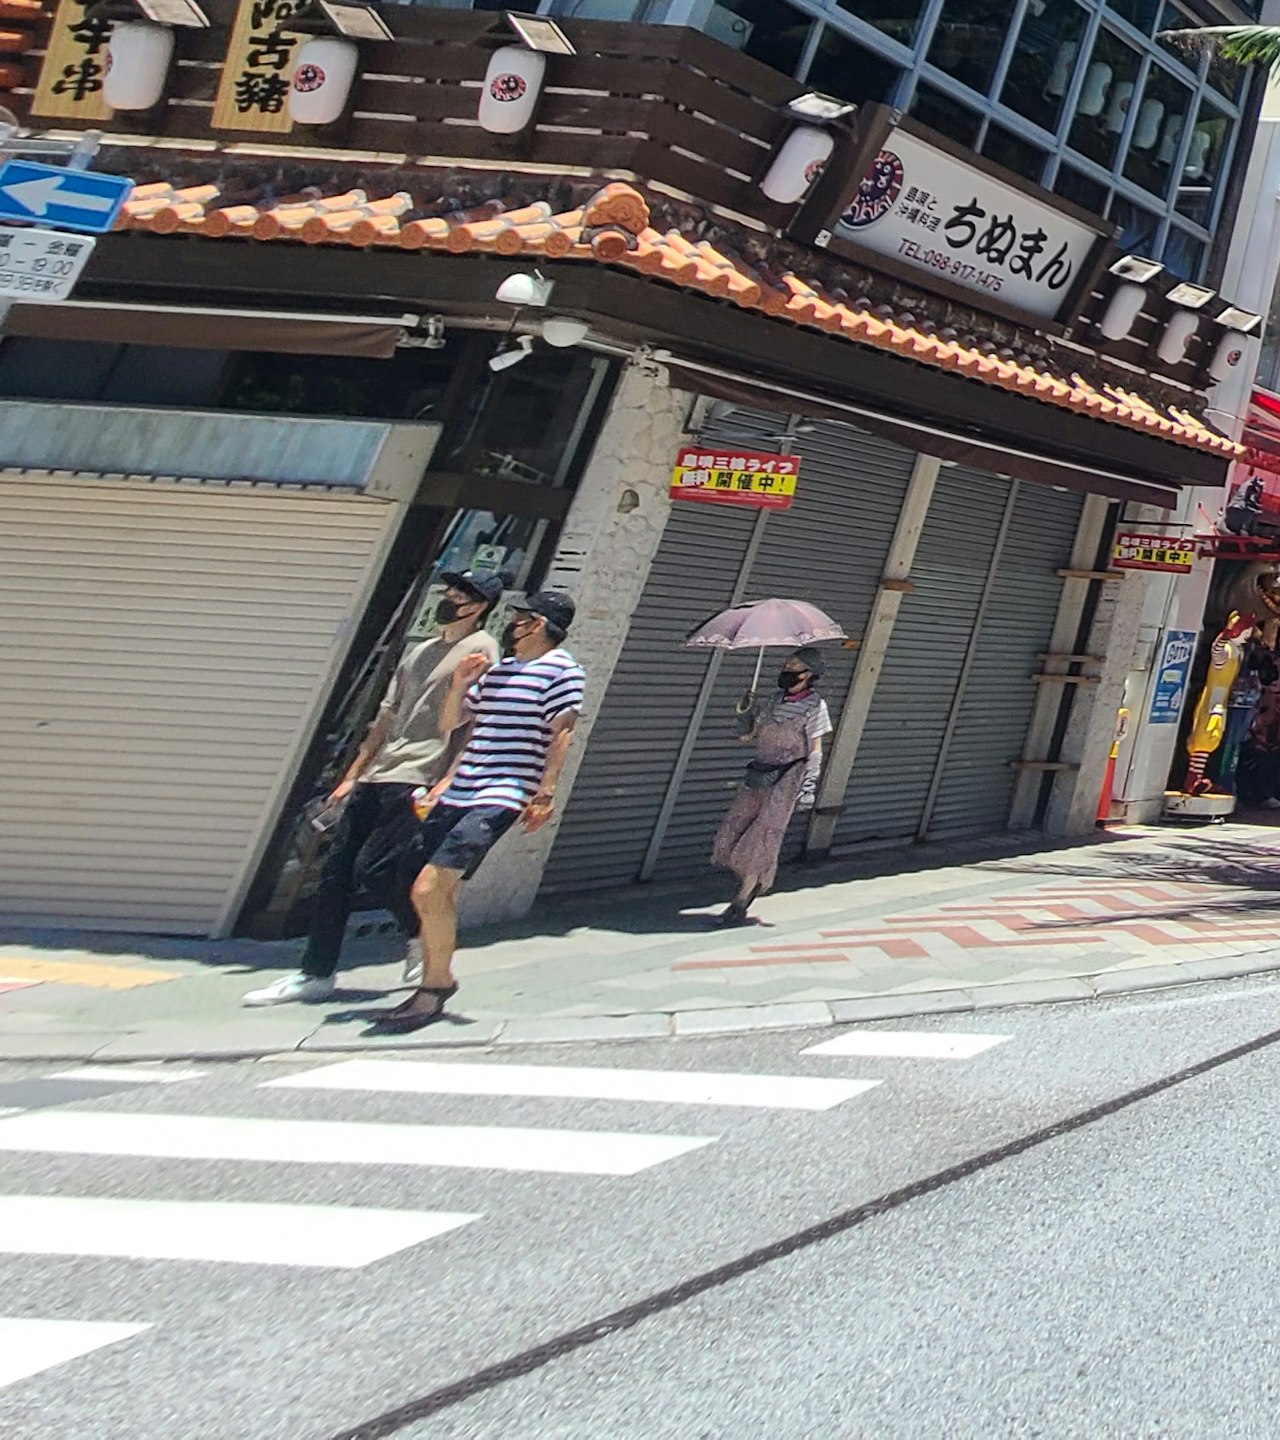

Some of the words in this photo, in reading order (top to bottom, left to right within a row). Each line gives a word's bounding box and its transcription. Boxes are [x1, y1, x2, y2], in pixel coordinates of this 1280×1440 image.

[898, 237, 1005, 292] TEL:098-917-1475
[944, 197, 1072, 290] ちぬまん
[714, 471, 786, 492] 開催中!
